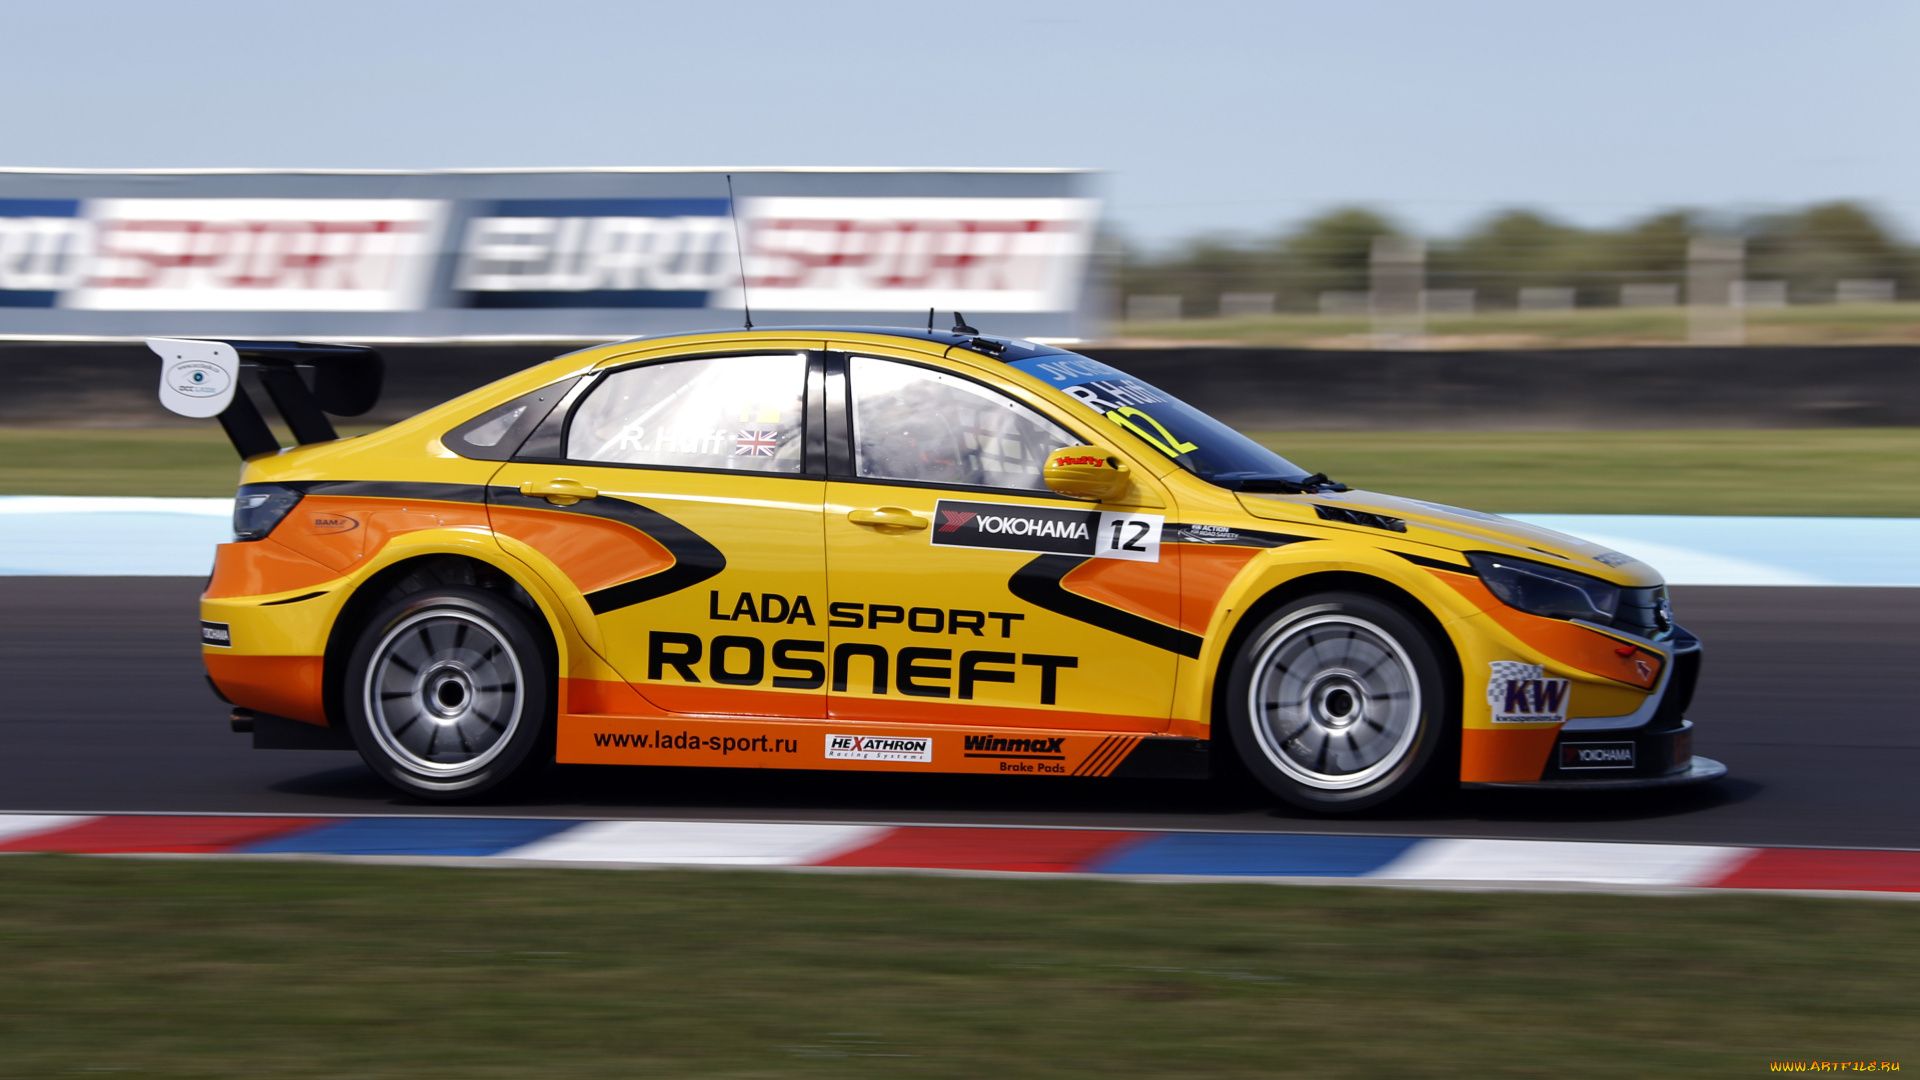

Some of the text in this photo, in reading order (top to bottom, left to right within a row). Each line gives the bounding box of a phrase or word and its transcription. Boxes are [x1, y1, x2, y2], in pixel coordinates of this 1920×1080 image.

[1106, 406, 1199, 458] 12
[1056, 456, 1106, 468] Huffy
[975, 515, 1090, 540] YOKOHAMA
[1109, 518, 1151, 552] 12
[1202, 525, 1230, 533] ACTION
[709, 590, 1026, 639] LADA SPORT
[647, 630, 1079, 706] ROSNEFT
[1503, 679, 1570, 714] KW
[593, 730, 798, 755] www.lada-sport.ru
[831, 736, 927, 752] HEXATHRON
[1578, 749, 1632, 761] YOKOHAMA
[829, 751, 924, 760] Racing Systems
[999, 762, 1066, 773] Brake Pads
